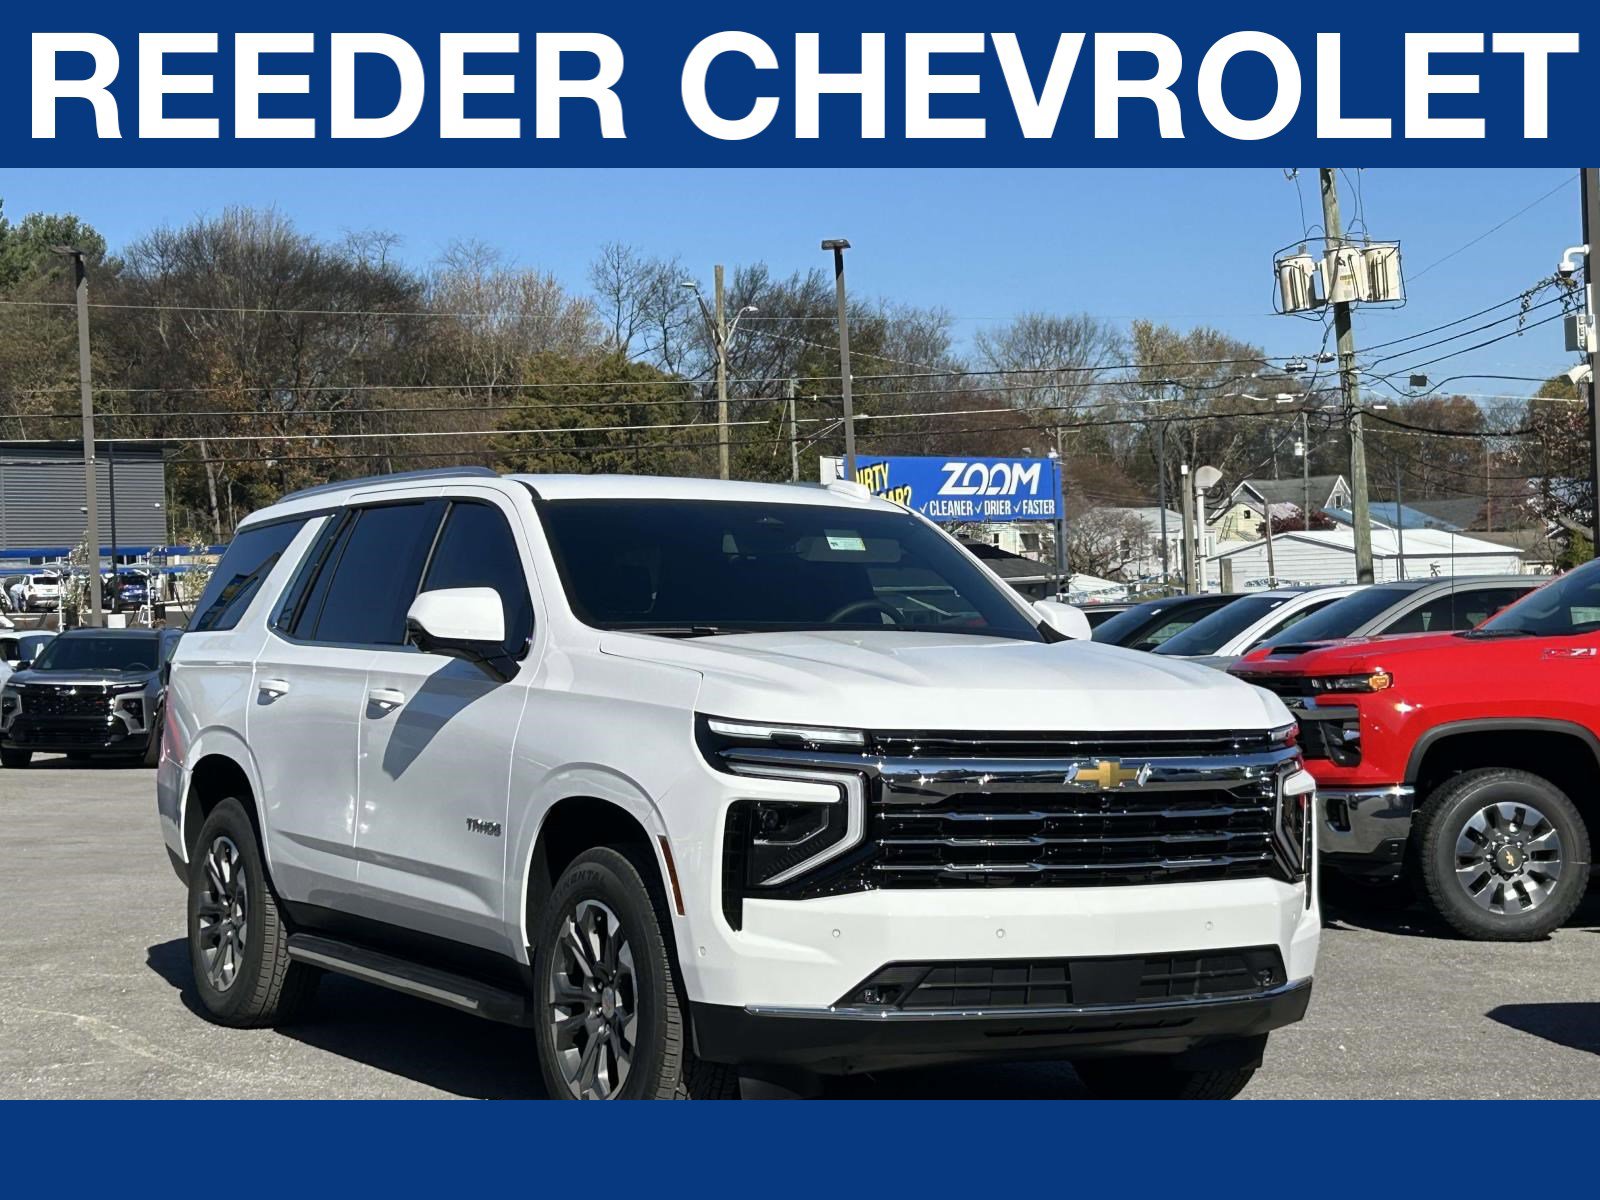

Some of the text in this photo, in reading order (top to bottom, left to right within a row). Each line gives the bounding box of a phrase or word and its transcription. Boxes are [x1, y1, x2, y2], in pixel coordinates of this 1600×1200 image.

[937, 462, 1041, 495] ZOOM
[879, 485, 912, 507] AR?
[929, 500, 1055, 516] CLEANER DRIER FASTER
